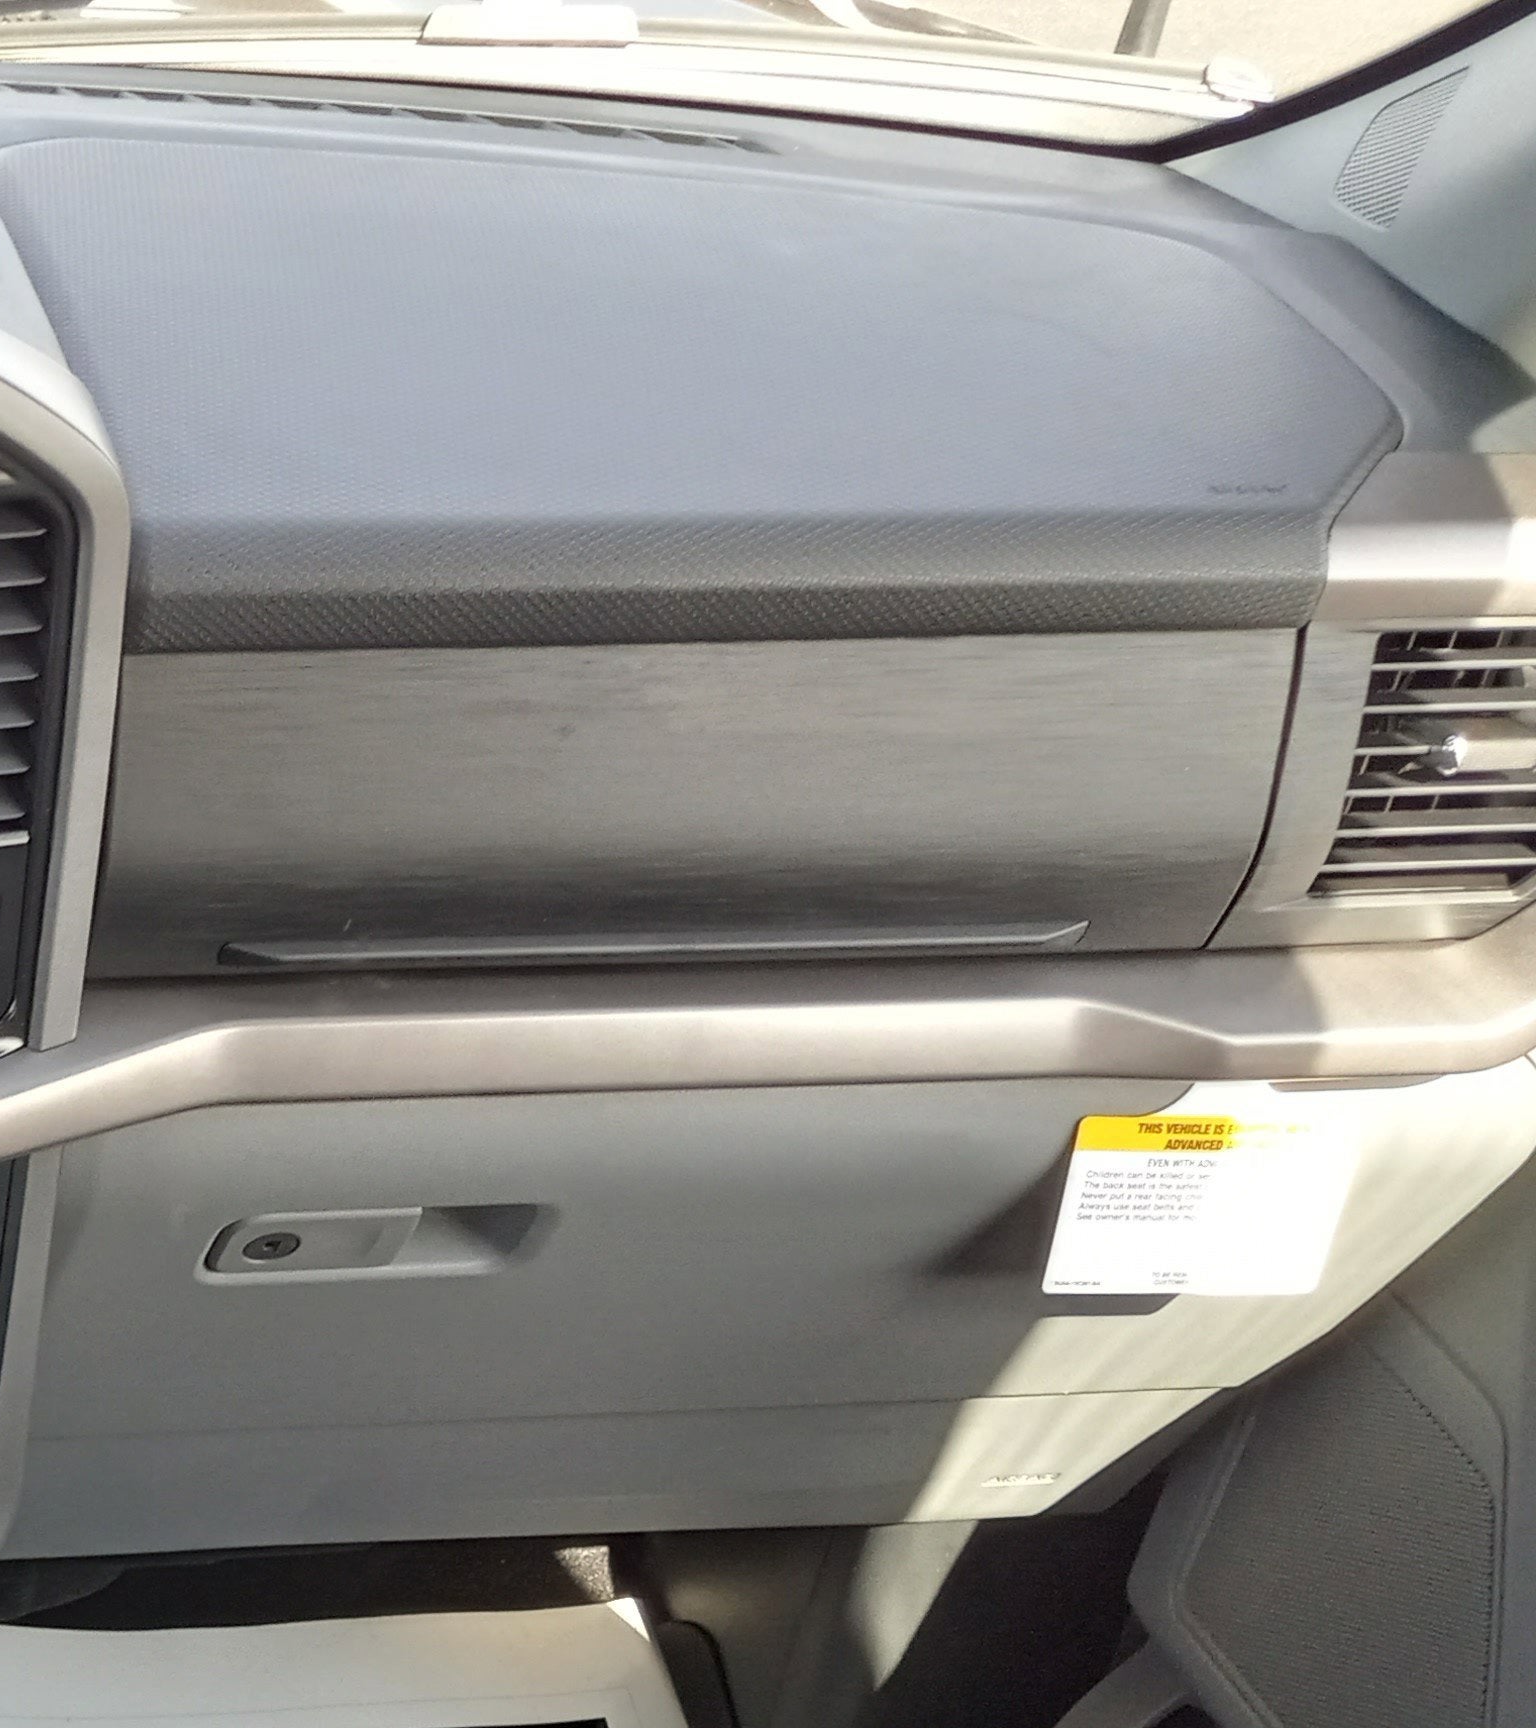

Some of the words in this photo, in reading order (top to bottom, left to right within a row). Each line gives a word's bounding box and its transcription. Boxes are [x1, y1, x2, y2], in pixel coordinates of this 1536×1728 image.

[1138, 1123, 1164, 1134] THIS
[1166, 1123, 1211, 1135] VEHICLE
[1213, 1124, 1225, 1135] IS
[1164, 1139, 1223, 1151] ADVANCED
[1086, 1170, 1124, 1179] Children
